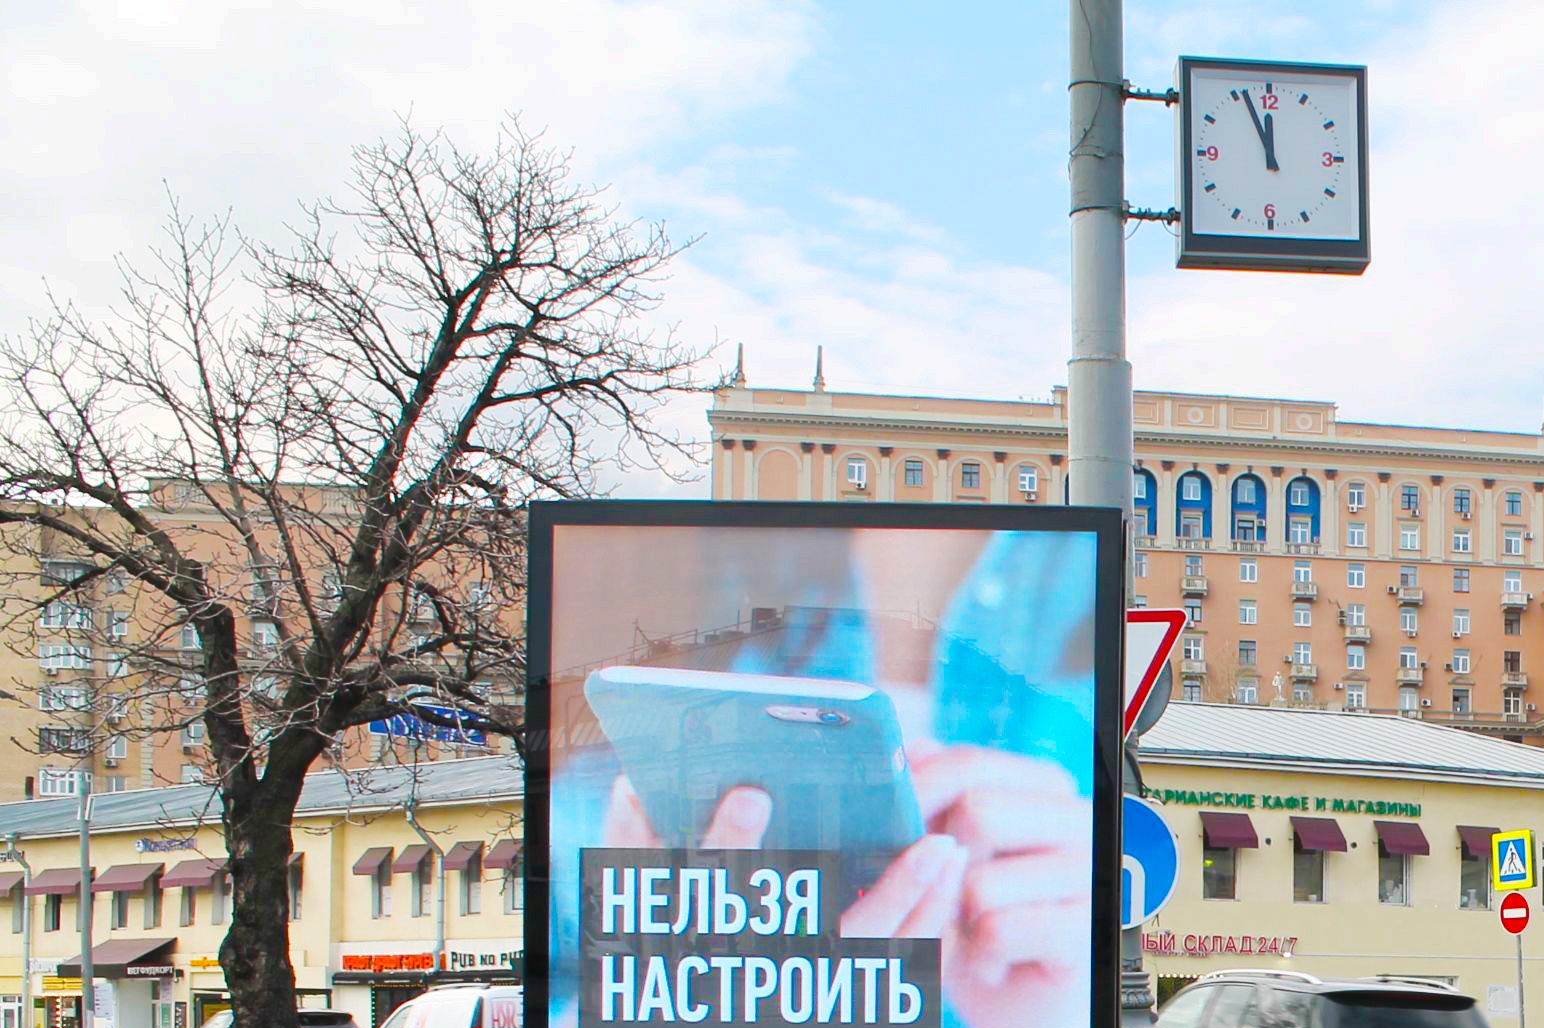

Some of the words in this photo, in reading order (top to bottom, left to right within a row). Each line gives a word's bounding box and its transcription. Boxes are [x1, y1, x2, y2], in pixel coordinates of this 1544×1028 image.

[1259, 94, 1279, 110] 12
[1206, 146, 1219, 160] 9
[1321, 152, 1334, 167] 3
[1263, 204, 1276, 218] 6
[1262, 795, 1309, 811] КАФЕ
[1315, 797, 1326, 811] И
[1332, 798, 1421, 817] МАГАЗИНЫ
[603, 867, 819, 936] НЕЛЬЗЯ
[1184, 933, 1253, 954] СКЛАД
[1258, 936, 1298, 953] 24/7
[451, 951, 476, 970] PUB
[480, 953, 496, 966] NO
[603, 955, 922, 1024] НАСТРОИТЬ
